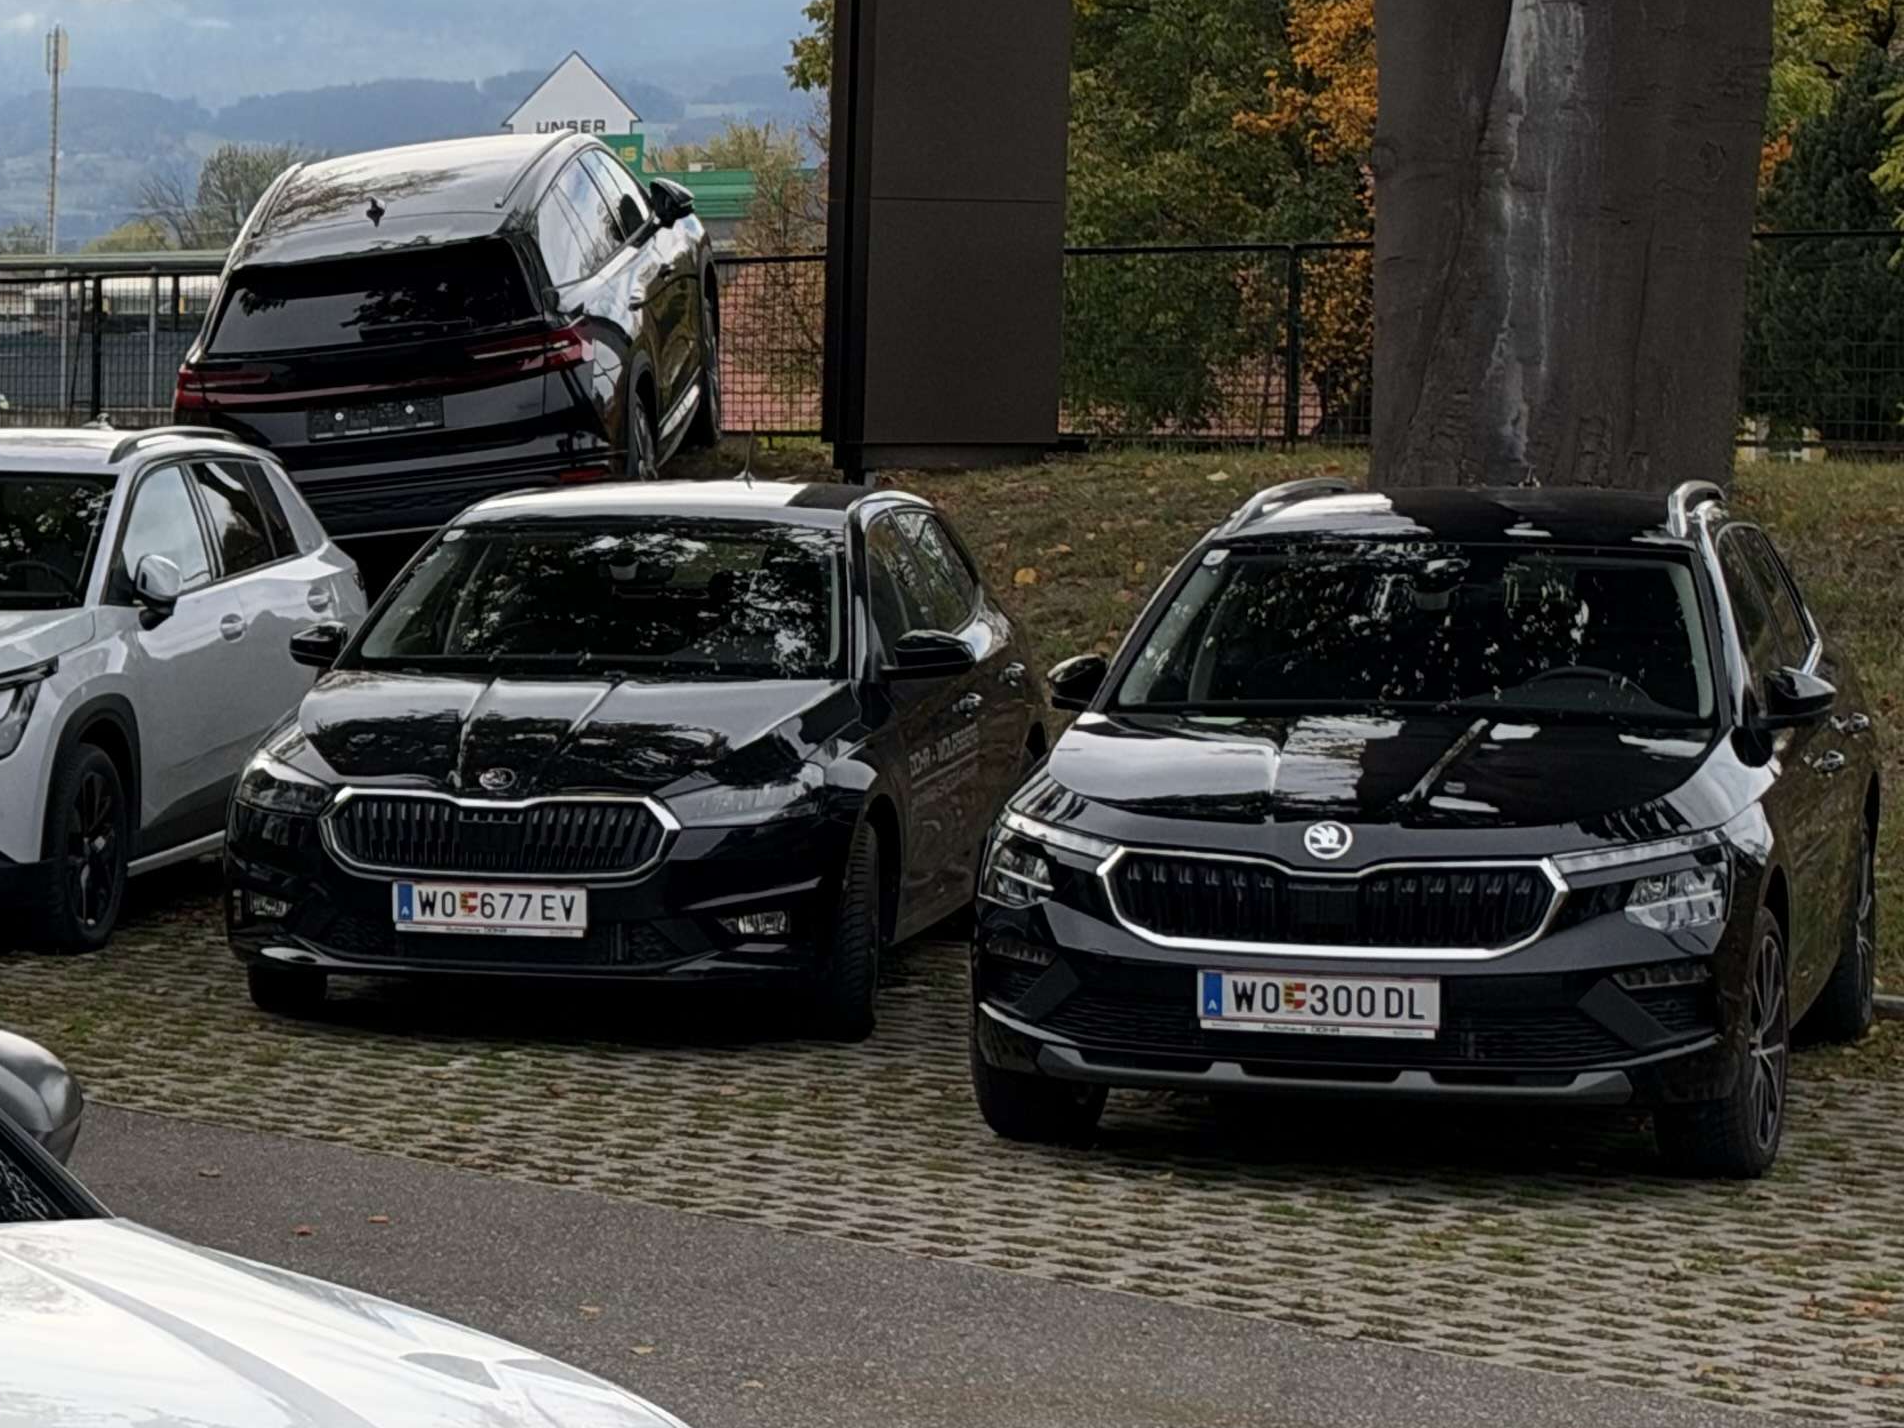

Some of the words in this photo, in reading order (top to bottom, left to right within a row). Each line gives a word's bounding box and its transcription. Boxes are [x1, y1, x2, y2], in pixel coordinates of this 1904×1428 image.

[535, 119, 606, 134] UNSER
[417, 890, 456, 918] WO
[1232, 980, 1280, 1014] WO
